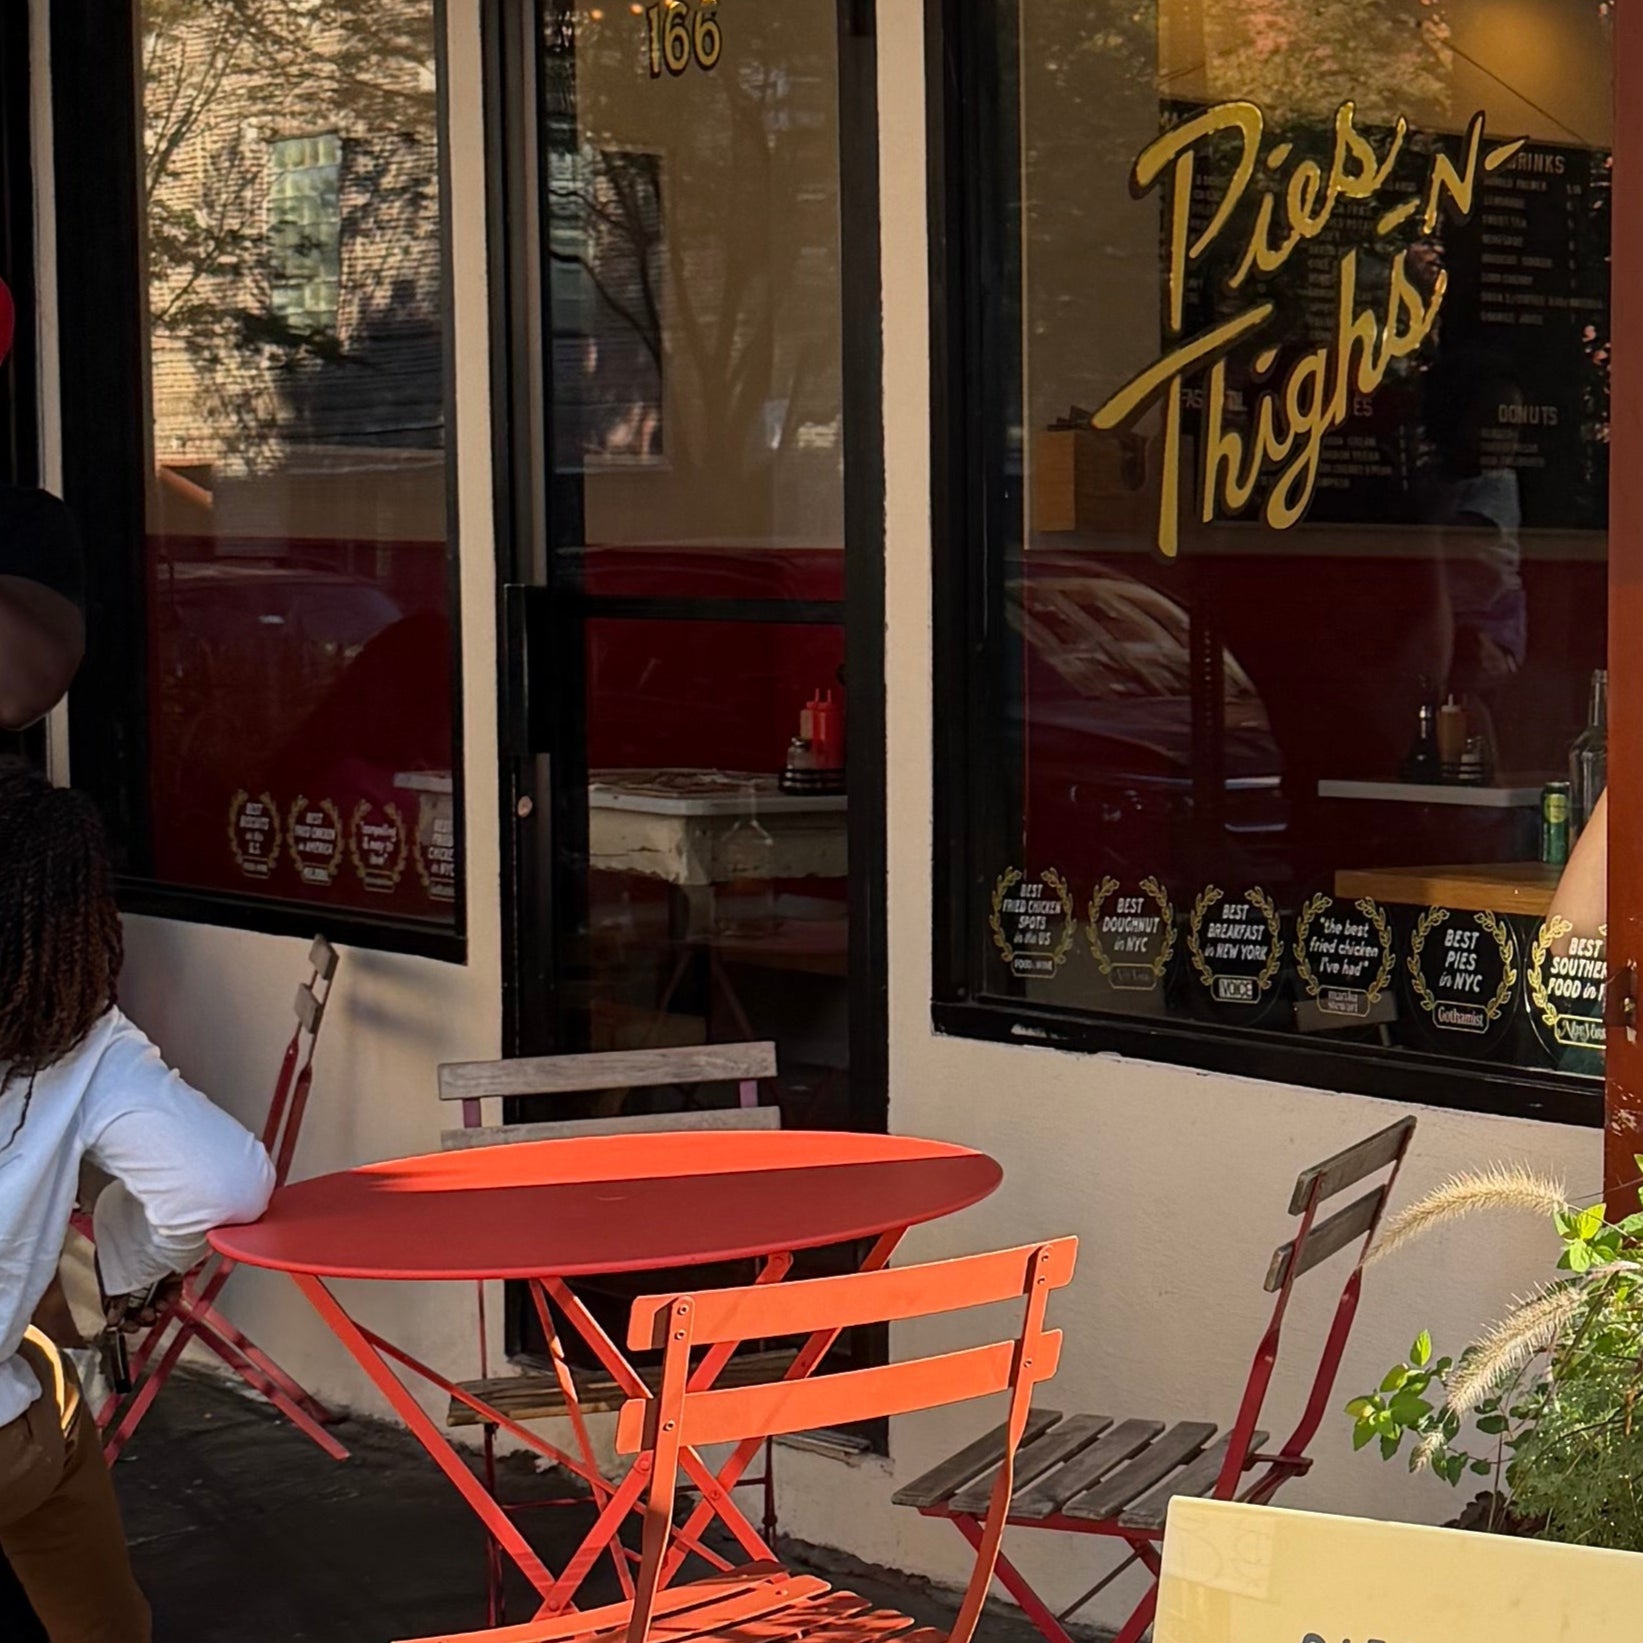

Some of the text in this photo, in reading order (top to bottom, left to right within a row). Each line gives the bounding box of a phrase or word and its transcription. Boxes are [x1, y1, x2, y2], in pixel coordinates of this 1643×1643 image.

[646, 0, 722, 78] 166
[1135, 101, 1406, 331] Pies
[1092, 250, 1447, 557] Thighs
[1498, 404, 1558, 426] DONUTS
[1020, 884, 1044, 898] BEST
[1002, 899, 1062, 914] FRIED CHICKEN
[1117, 898, 1145, 914] BEST
[1222, 904, 1250, 920] BEST
[1018, 916, 1047, 930] SPOTS
[1102, 916, 1161, 934] DOUGHNUT
[1207, 923, 1266, 941] BREAKFAST
[1344, 918, 1370, 938] best
[1037, 932, 1052, 945] US
[1125, 936, 1149, 952] NYC
[1309, 936, 1379, 957] fried chicken
[1444, 929, 1480, 950] BEST
[1568, 937, 1604, 958] BEST
[1215, 943, 1239, 960] NEW
[1240, 944, 1269, 961] YORK
[1445, 951, 1477, 971] PIES
[1319, 956, 1339, 974] I've
[1550, 956, 1608, 980] SOUTHER
[1439, 970, 1484, 993] in NYC
[1547, 977, 1582, 999] FOOD
[1582, 982, 1598, 1000] in
[1437, 1006, 1485, 1028] Gothamist
